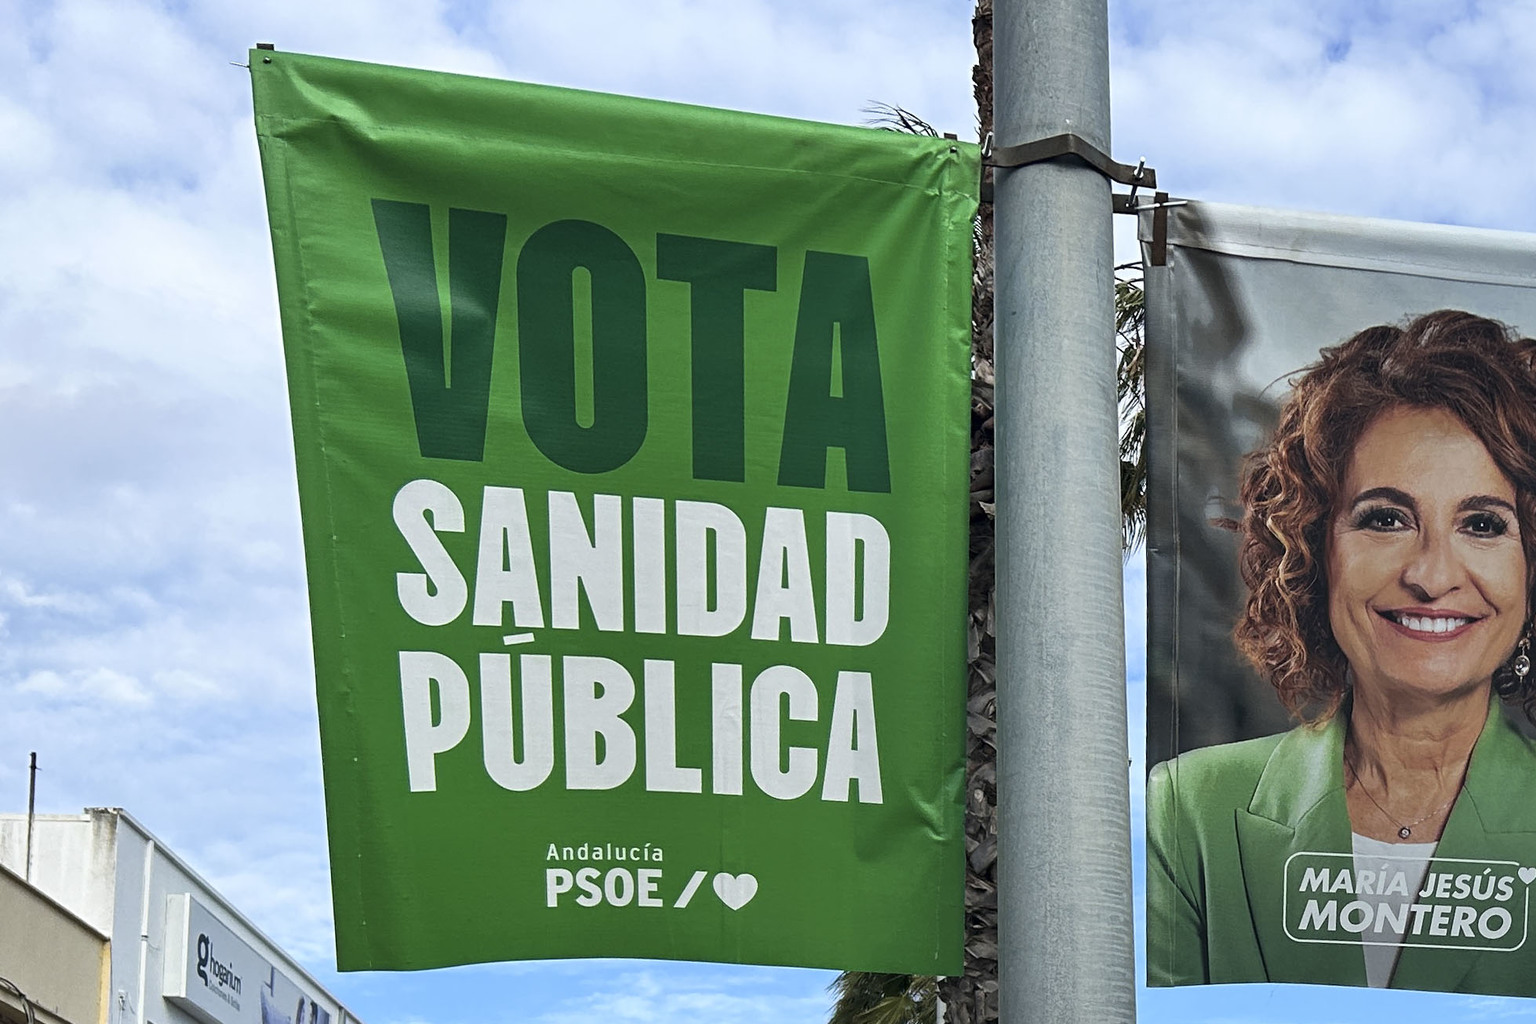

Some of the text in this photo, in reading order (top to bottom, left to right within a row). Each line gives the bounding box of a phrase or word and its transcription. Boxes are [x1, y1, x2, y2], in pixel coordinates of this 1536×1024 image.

[371, 198, 892, 494] VOTA
[392, 478, 892, 647] SANIDAD
[398, 632, 884, 804] PÚBLICA
[546, 843, 664, 862] Andalucía
[546, 867, 664, 908] PSOE
[1299, 863, 1516, 902] MARÍA JESÚS
[1298, 899, 1513, 940] MONTERO
